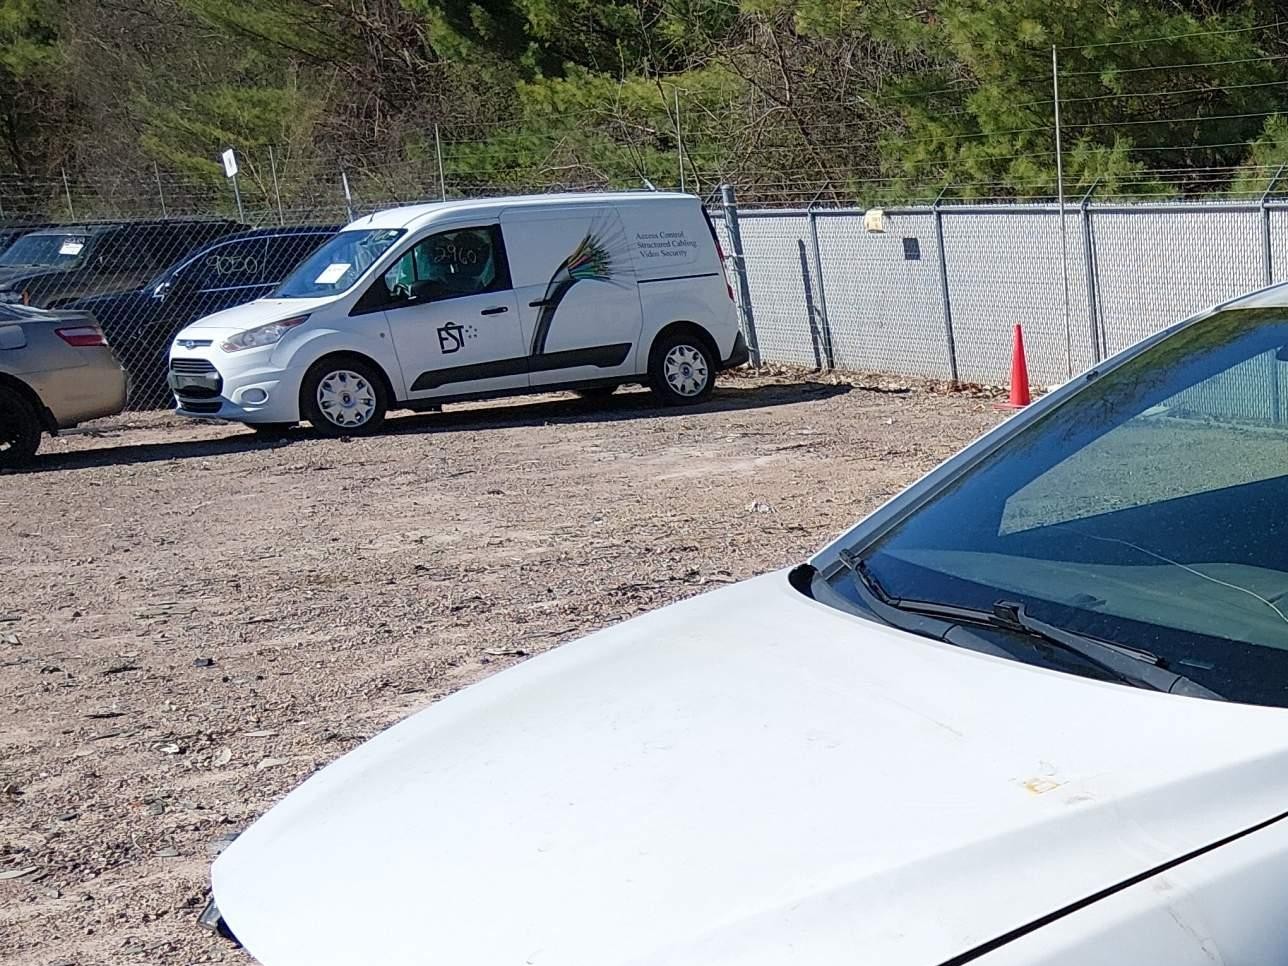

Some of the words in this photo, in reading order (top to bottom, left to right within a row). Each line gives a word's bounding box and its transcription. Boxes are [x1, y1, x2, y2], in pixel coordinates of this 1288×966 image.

[635, 231, 658, 240] Access
[659, 230, 684, 238] Control
[637, 240, 671, 249] Structured
[671, 239, 697, 248] Cabling
[433, 243, 478, 265] 2960
[640, 250, 660, 258] Video
[661, 248, 687, 257] Security
[206, 254, 258, 276] 9050
